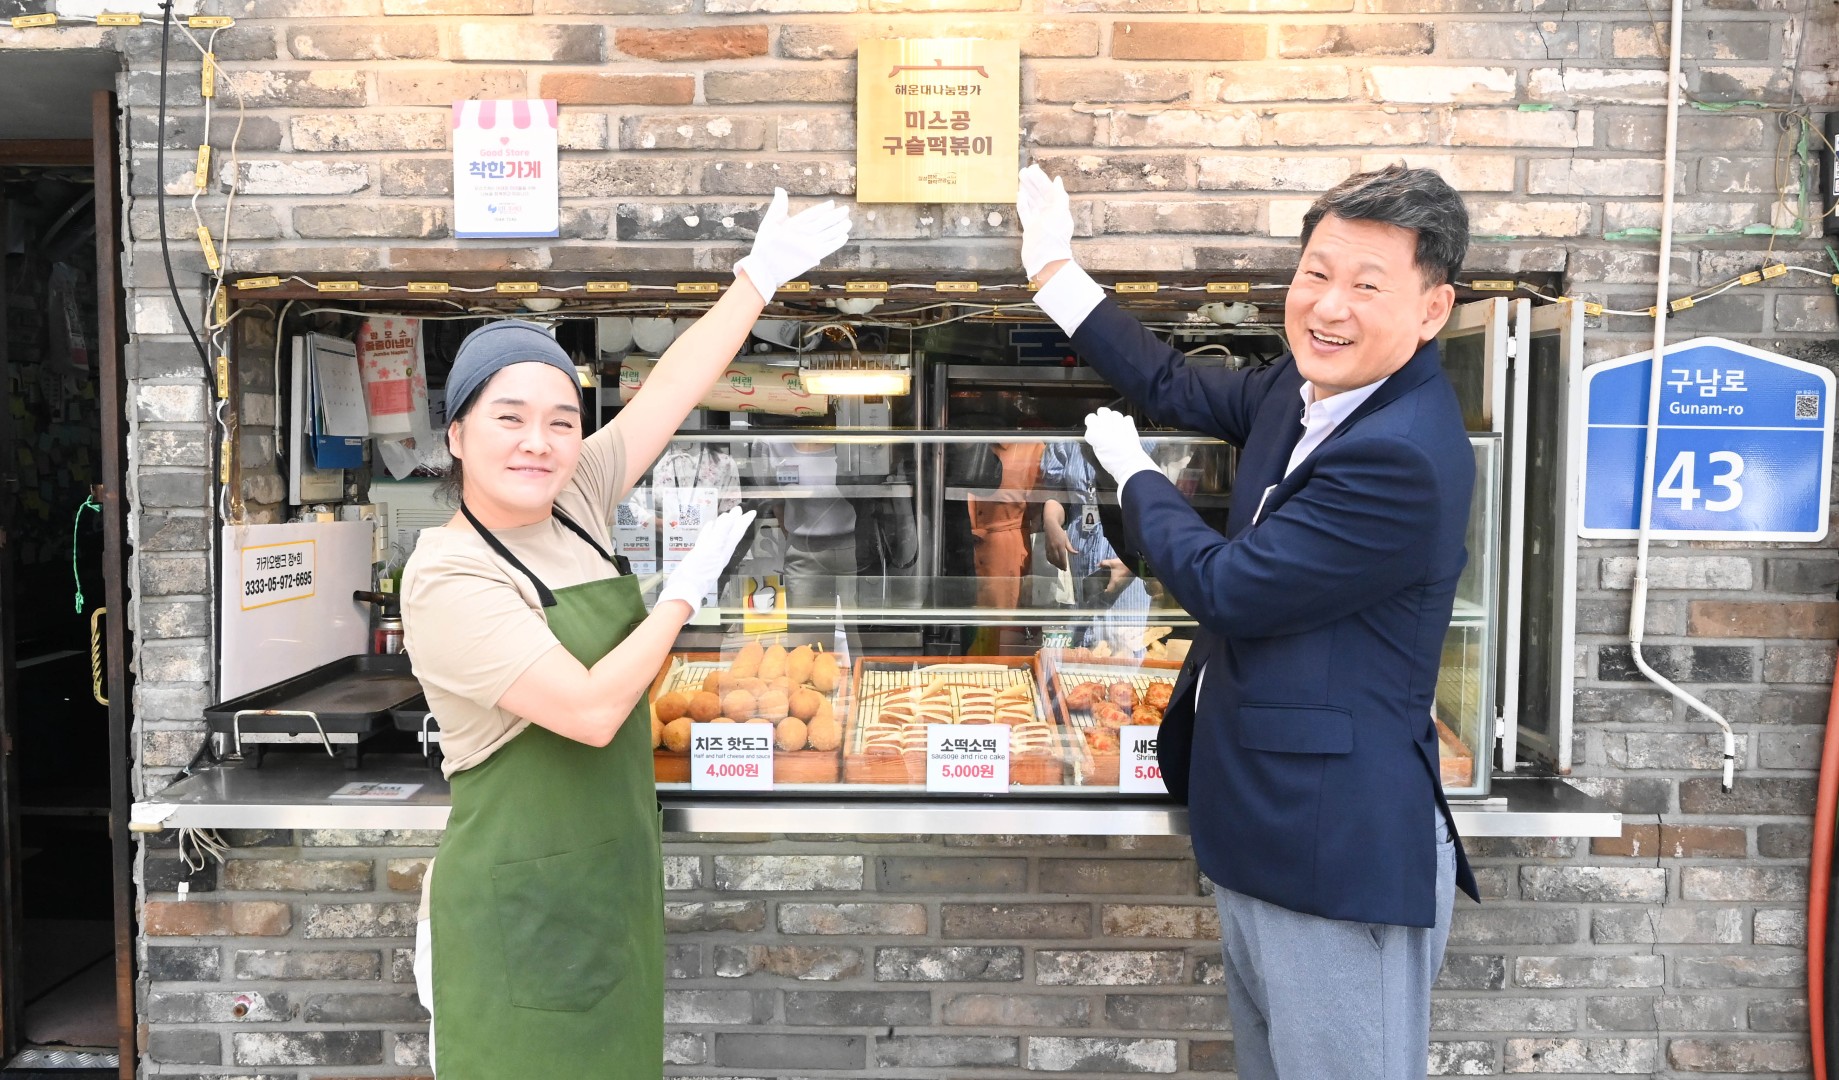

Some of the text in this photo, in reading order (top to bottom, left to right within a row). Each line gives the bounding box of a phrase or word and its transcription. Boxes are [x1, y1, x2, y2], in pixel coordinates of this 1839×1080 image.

[895, 84, 981, 96] 해운대나눔명가
[905, 110, 971, 130] 미스공
[882, 136, 992, 156] 구슬떡볶이
[469, 161, 541, 178] 착한가게
[731, 376, 752, 388] 썬랩
[1667, 369, 1747, 397] 구남로
[1669, 402, 1744, 415] Gunam-ro
[1657, 451, 1745, 512] 43
[256, 555, 286, 570] 카카오뱅크
[245, 571, 312, 596] 3333-05-972-6695
[1042, 634, 1072, 648] Sprite
[696, 737, 768, 750] 치즈 핫도그
[941, 739, 996, 753] 소떡소떡
[1133, 740, 1157, 753] 새우
[706, 764, 758, 777] 4,000원
[942, 765, 993, 778] 5,000원
[1135, 766, 1162, 779] 5,00
